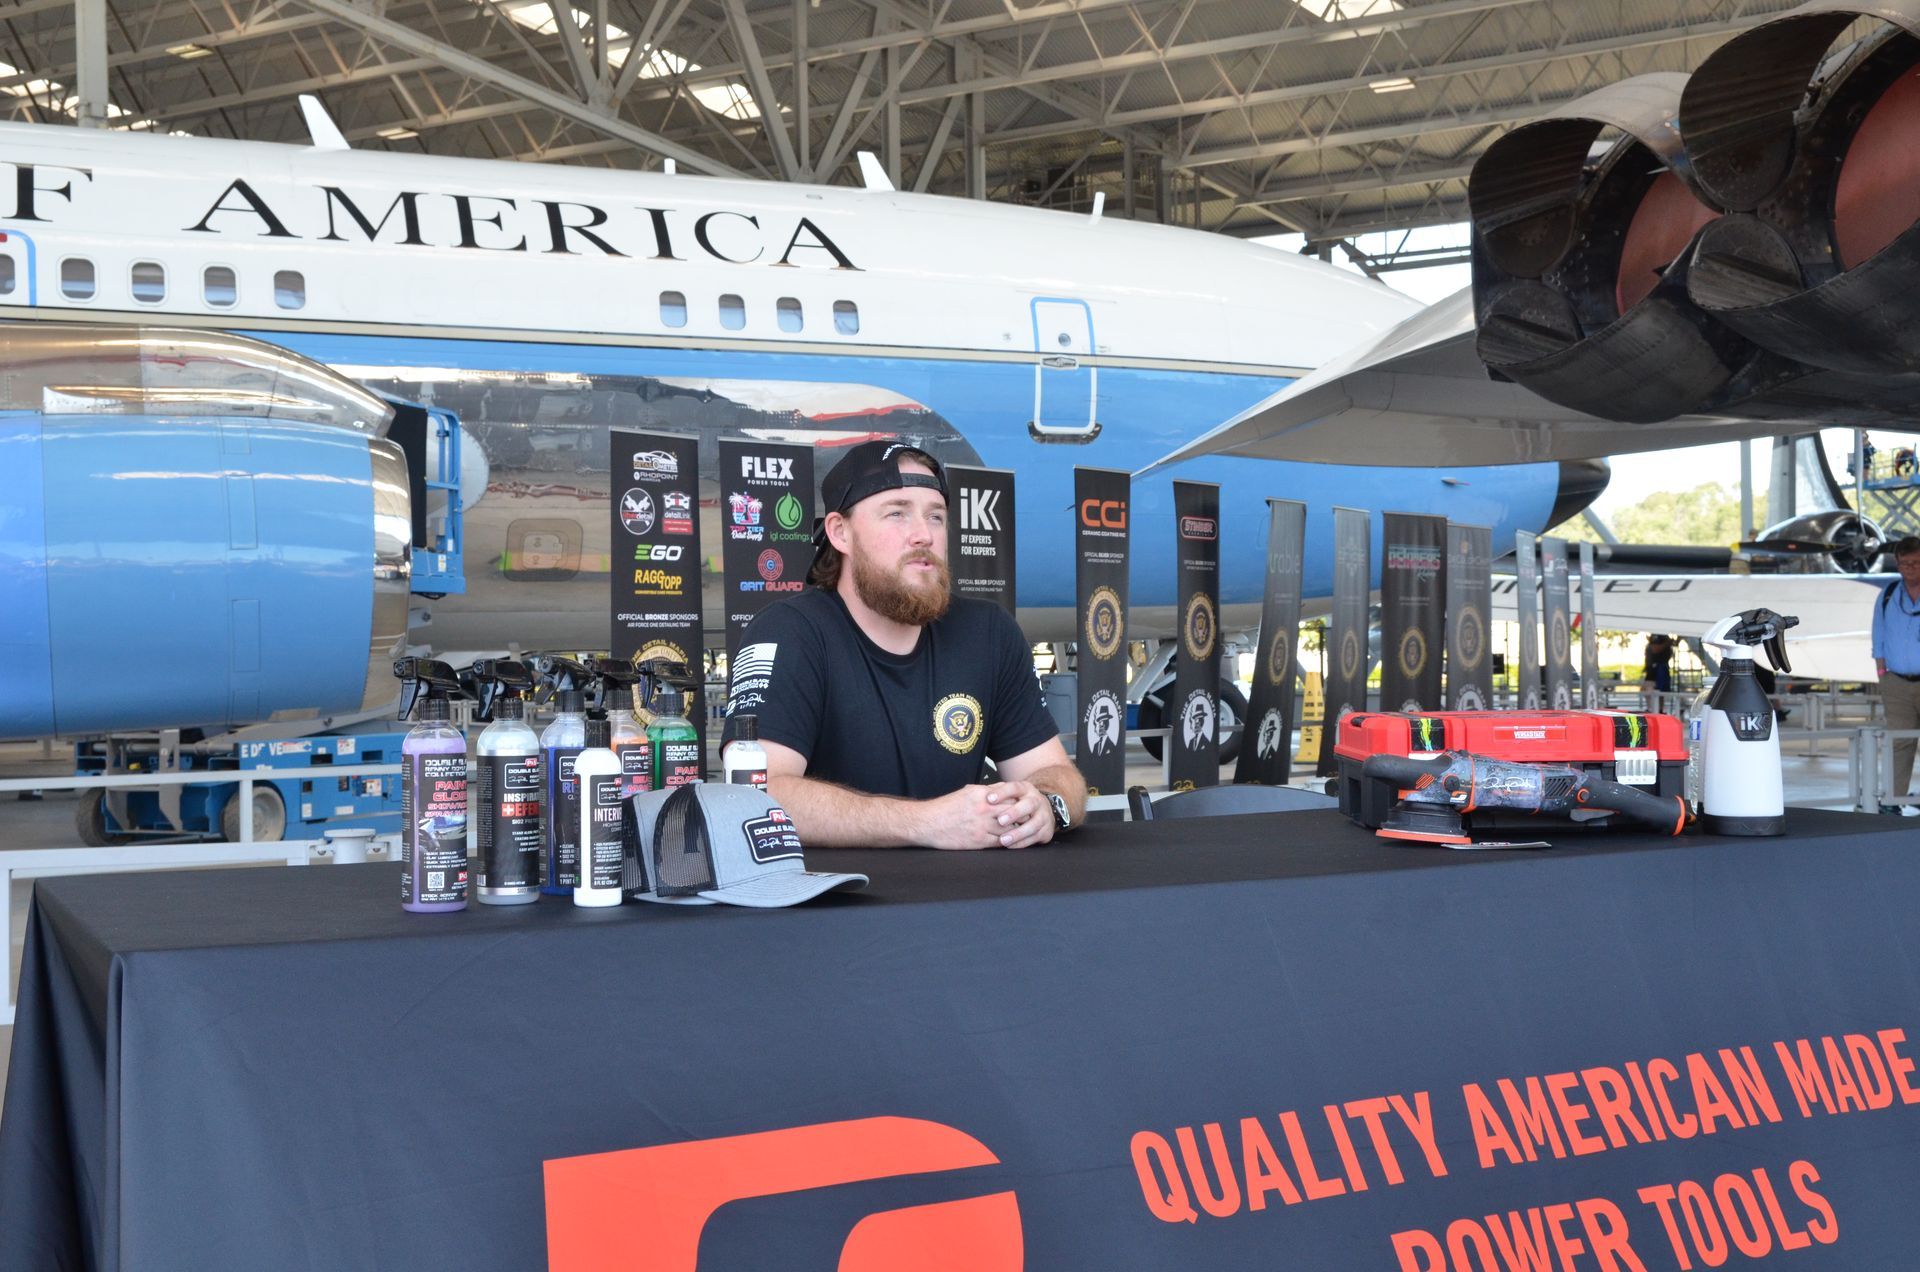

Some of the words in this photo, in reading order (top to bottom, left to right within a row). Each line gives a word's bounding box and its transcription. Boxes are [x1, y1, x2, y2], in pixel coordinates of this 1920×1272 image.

[181, 178, 866, 272] AMERICA
[741, 455, 794, 480] FLEX
[780, 532, 810, 543] coatings
[961, 534, 969, 543] BY
[969, 534, 992, 545] EXPERTS
[634, 544, 682, 561] EGO
[961, 546, 972, 555] FOR
[973, 546, 996, 556] EXPERTS
[740, 581, 765, 591] GRIT
[765, 581, 804, 592] GUARD
[617, 613, 644, 621] OFFICIAL
[645, 613, 669, 621] BRONZE
[669, 613, 698, 621] SPONSORS
[1091, 689, 1111, 703] DETAIL
[1740, 715, 1759, 731] iK
[754, 825, 782, 836] DOUBLE
[1130, 1091, 1448, 1224] QUALITY
[1463, 1047, 1782, 1169] AMERICAN
[1774, 1028, 1920, 1118] MADE
[1637, 1160, 1840, 1271] TOOLS
